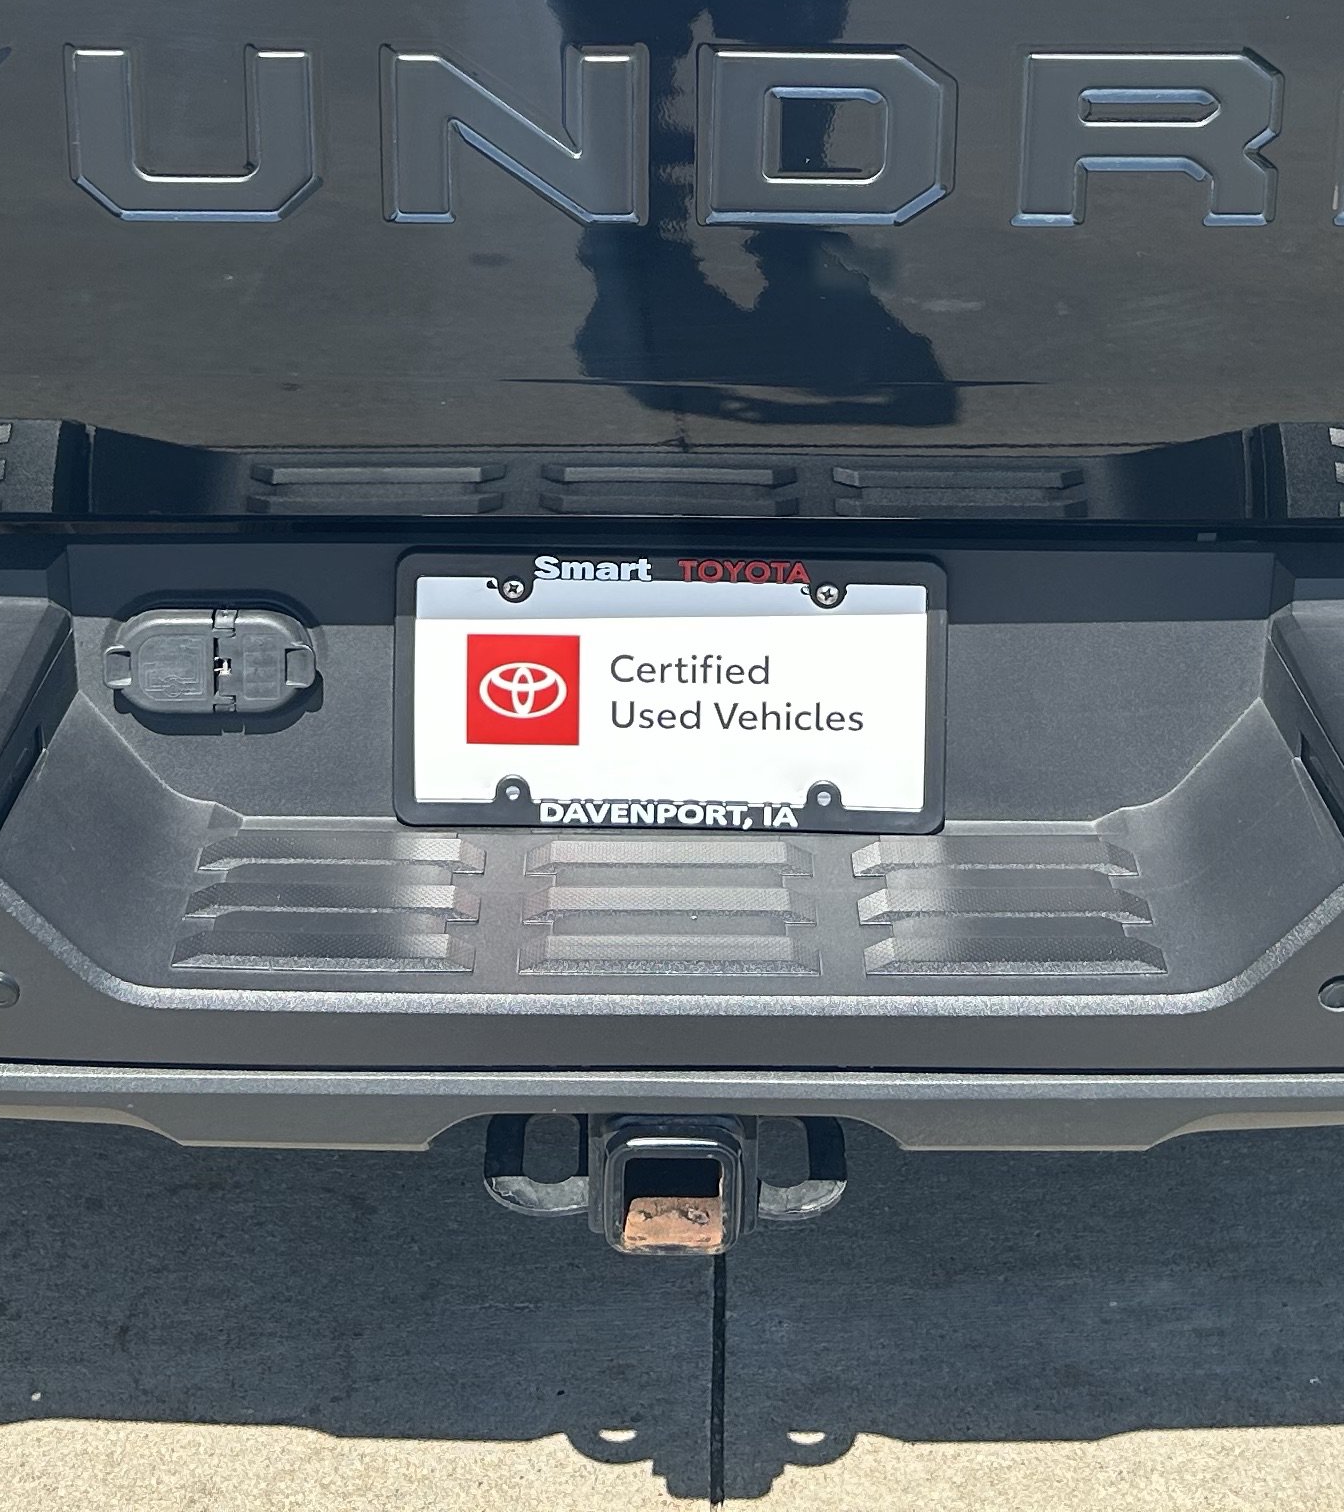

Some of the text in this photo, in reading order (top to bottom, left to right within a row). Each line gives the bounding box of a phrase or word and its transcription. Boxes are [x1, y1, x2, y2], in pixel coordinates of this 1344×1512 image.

[533, 555, 811, 584] Smart TOYOTA
[609, 654, 771, 685] Certified
[610, 700, 865, 732] Used Vehicles
[540, 803, 799, 830] DAVENPORT, IA
